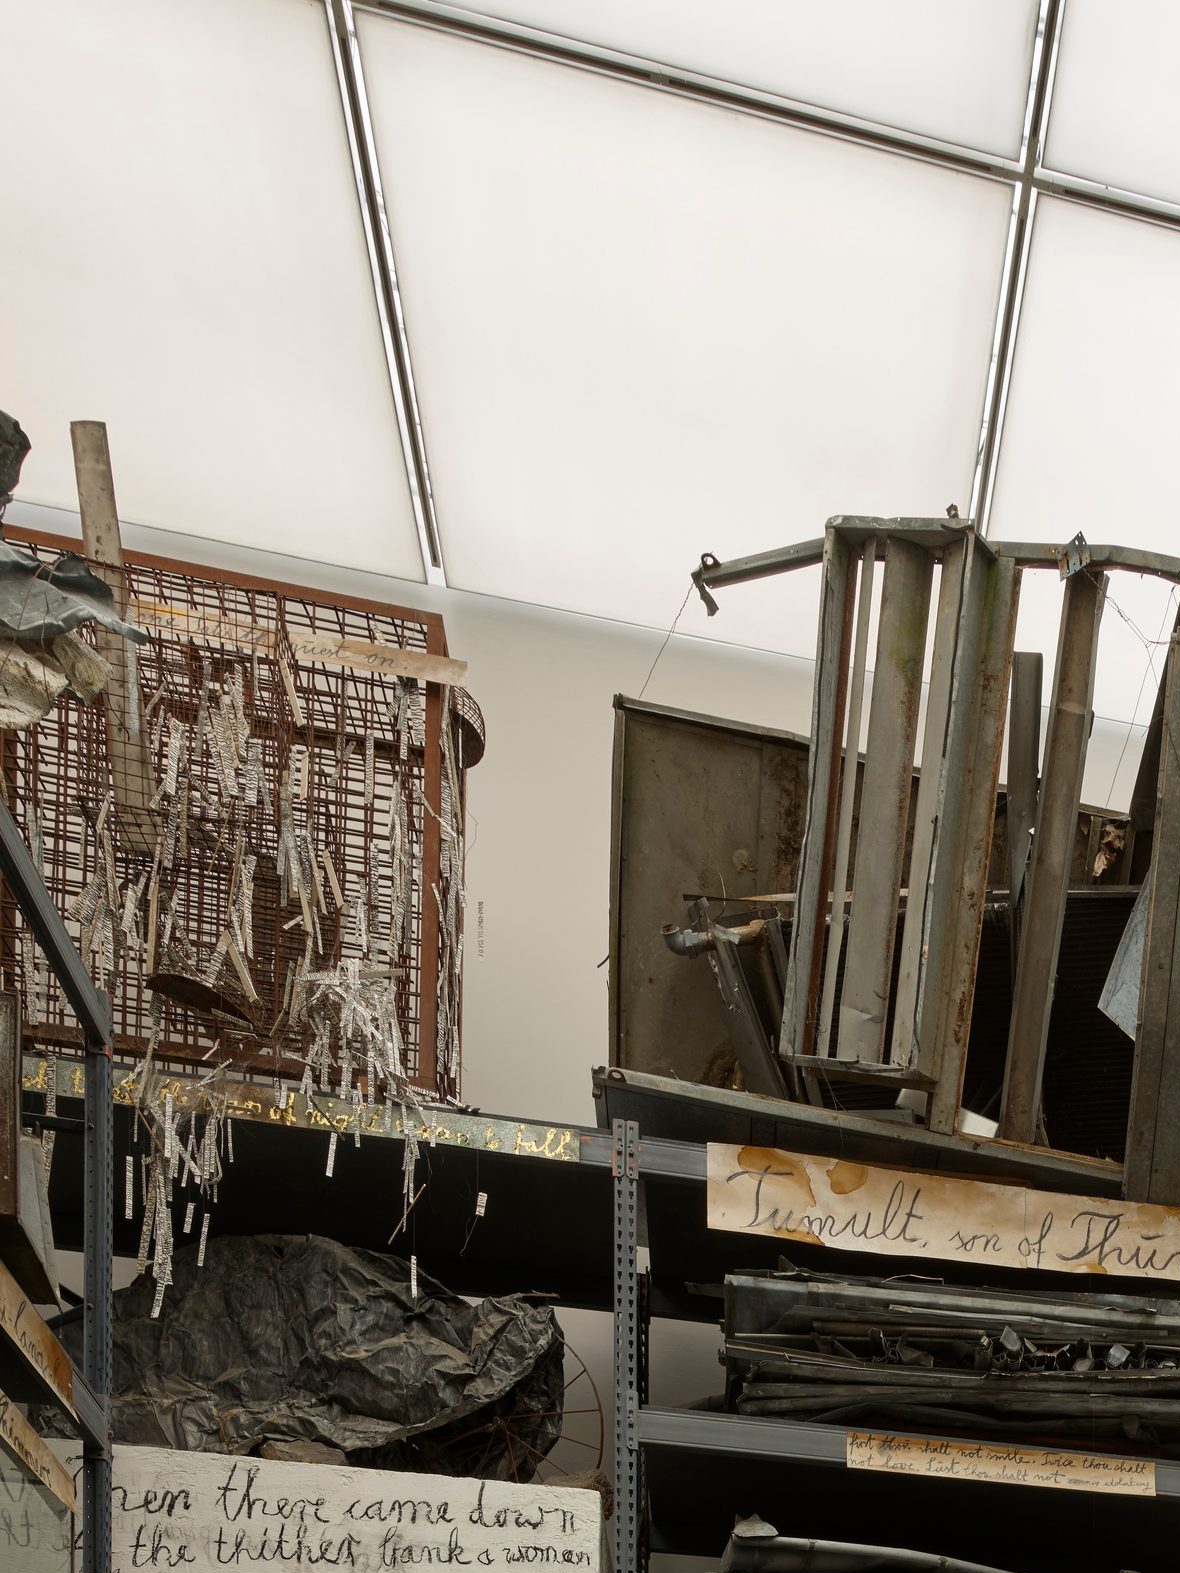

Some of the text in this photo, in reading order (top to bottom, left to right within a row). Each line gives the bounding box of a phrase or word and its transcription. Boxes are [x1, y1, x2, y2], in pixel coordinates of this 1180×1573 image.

[513, 1124, 571, 1161] fall
[951, 1230, 1002, 1253] son
[1018, 1211, 1052, 1268] of
[848, 1454, 874, 1467] not
[963, 1462, 992, 1478] thou
[995, 1465, 1029, 1482] shalt
[1033, 1470, 1066, 1484] not
[916, 1440, 951, 1456] shalt
[957, 1445, 983, 1459] not
[1041, 1452, 1076, 1468] Twice
[1081, 1457, 1112, 1471] thou
[1113, 1460, 1147, 1474] shalt
[217, 1461, 330, 1523] there
[341, 1492, 455, 1525] came
[467, 1480, 577, 1534] down
[130, 1523, 198, 1568] the
[213, 1521, 364, 1567] thither
[375, 1526, 473, 1568] bank
